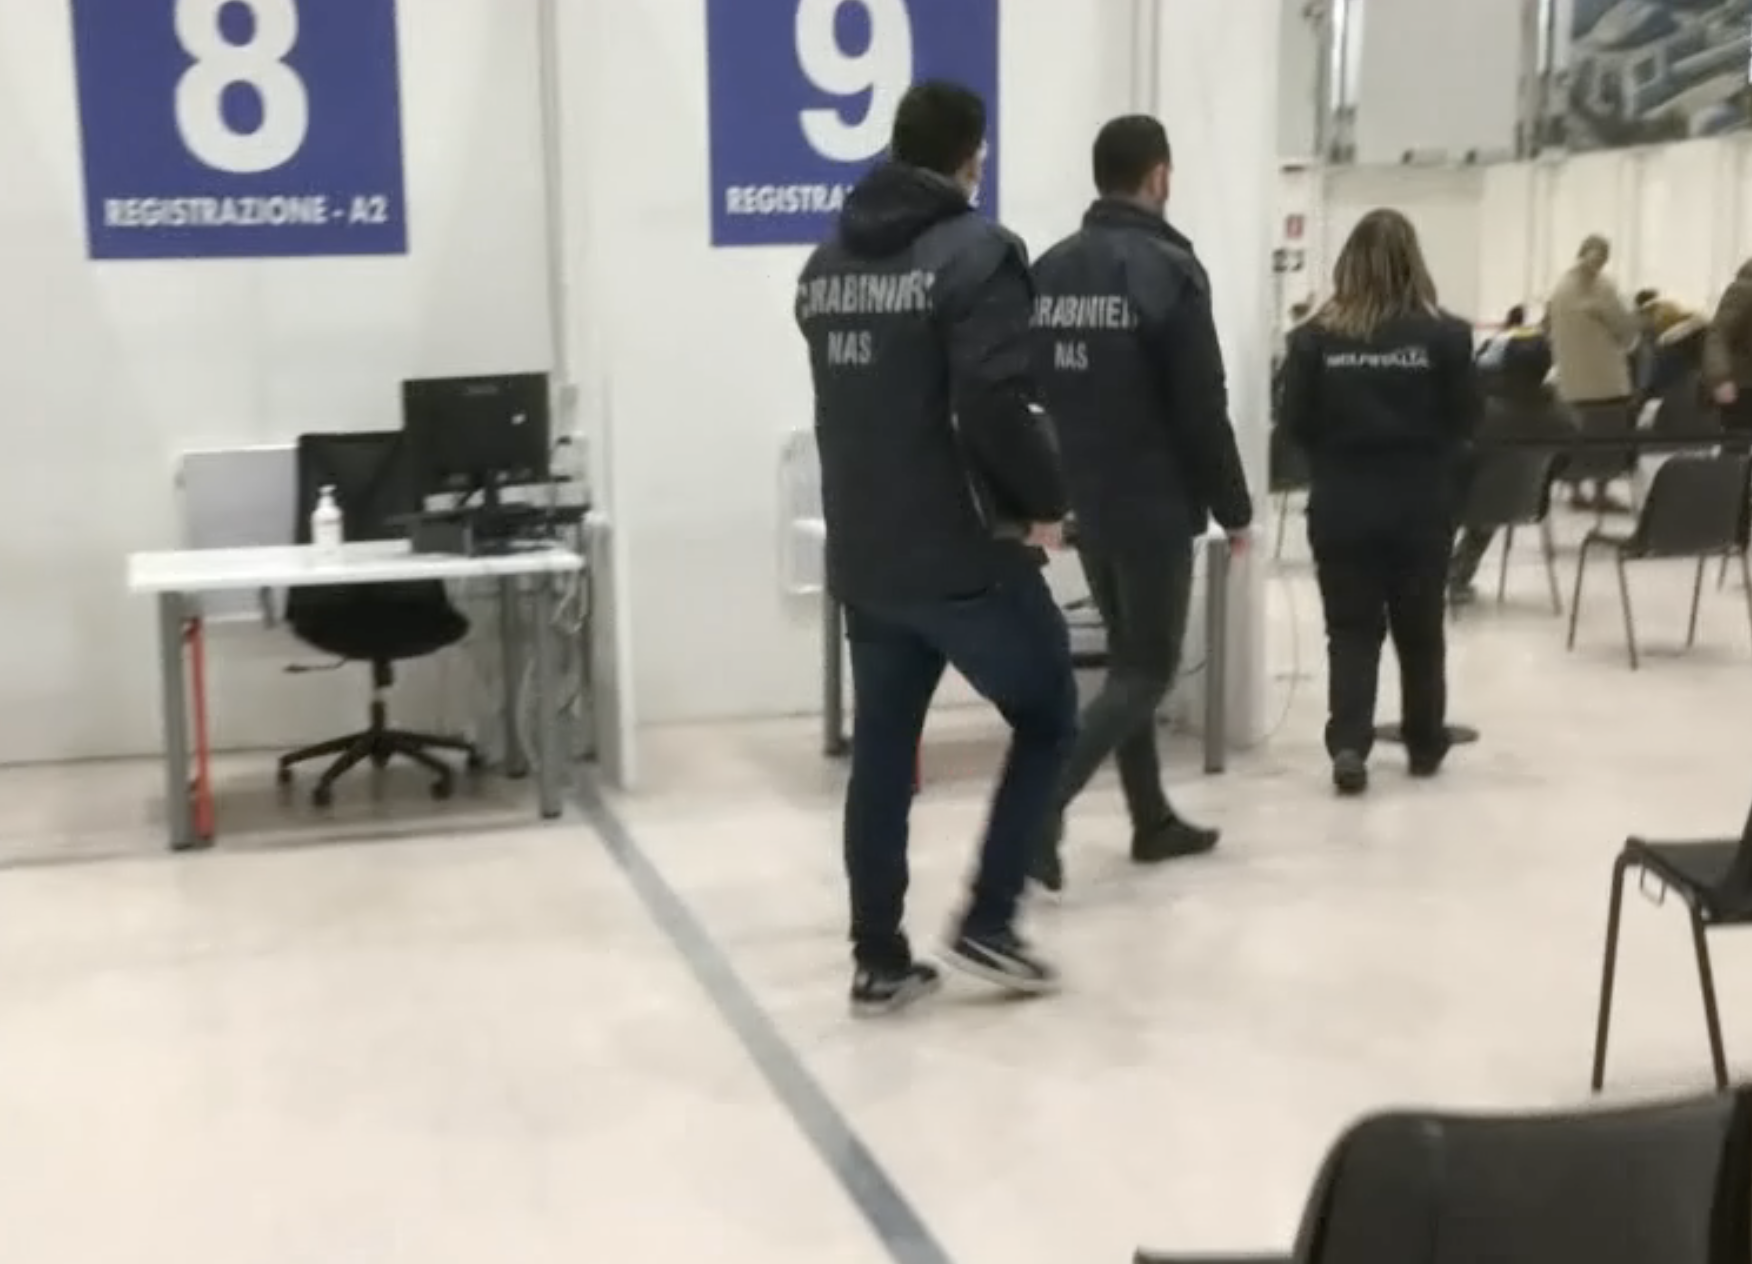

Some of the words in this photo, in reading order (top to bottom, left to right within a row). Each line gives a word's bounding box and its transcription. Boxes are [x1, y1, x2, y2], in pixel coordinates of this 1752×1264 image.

[174, 0, 309, 173] 8
[795, 0, 912, 162] 9
[104, 196, 327, 227] REGISTRAZIONE
[350, 195, 389, 224] A2
[725, 184, 854, 214] REGISTRA
[827, 330, 872, 366] NAS
[1054, 341, 1088, 371] NAS
